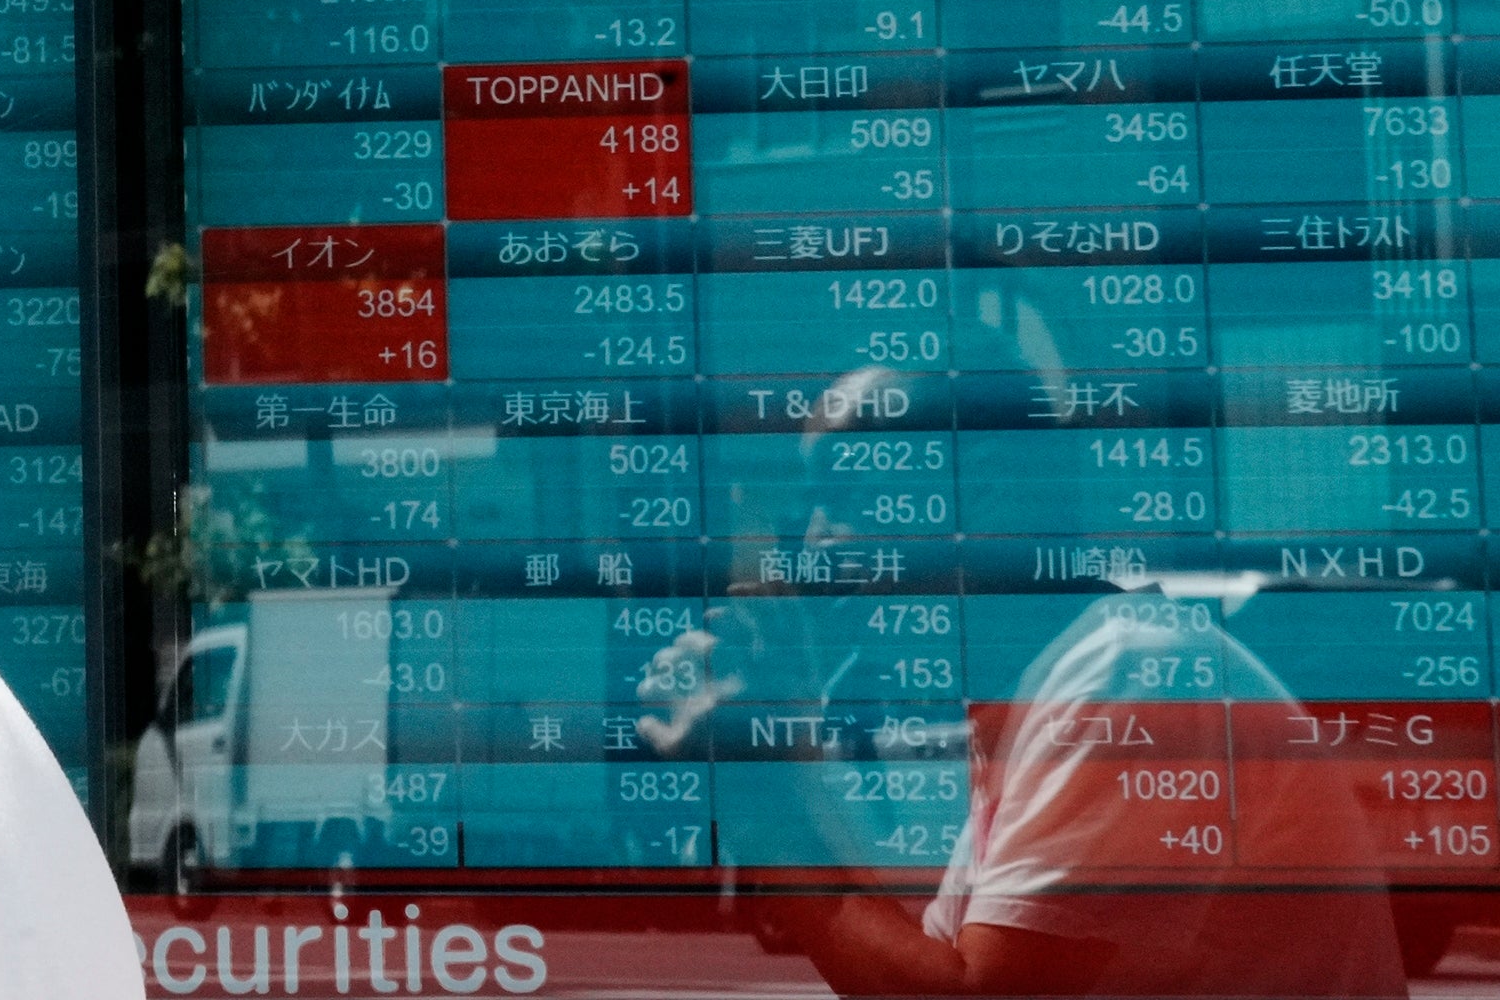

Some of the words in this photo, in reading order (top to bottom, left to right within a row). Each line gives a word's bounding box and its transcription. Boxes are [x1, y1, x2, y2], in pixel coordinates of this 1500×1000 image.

[760, 64, 868, 100] 大日印
[1013, 60, 1125, 94] ヤマハ
[1270, 52, 1382, 87] 任天堂
[467, 73, 664, 106] TOPPANHD
[600, 125, 679, 153] 4188
[850, 119, 931, 147] 5069
[1105, 113, 1187, 142] 3456
[354, 132, 431, 159] 3229
[623, 178, 680, 203] +14
[500, 229, 639, 263] あおぞら
[753, 225, 889, 262] 三菱UFJ
[997, 220, 1159, 254] りそなHD
[273, 236, 374, 269] イオン
[357, 289, 434, 317] 3854
[574, 285, 684, 313] 2483.5
[827, 279, 937, 308] 1422.0
[1082, 275, 1194, 304] 1028.0
[378, 342, 437, 369] +16
[584, 337, 685, 365] -124.5
[255, 393, 397, 429] 第一生命
[503, 391, 646, 425] 東京海上
[1029, 383, 1139, 417] 三井不
[1287, 378, 1400, 414] 菱地所
[609, 446, 688, 474] 5024
[1090, 438, 1202, 468] 1414.5
[252, 557, 410, 587] ヤマトHD
[759, 549, 904, 584] 商船三井
[1034, 547, 1147, 581] 川崎船
[868, 605, 950, 633] 4736
[1392, 603, 1474, 631] 7024
[281, 718, 384, 750] 大ガス
[1046, 714, 1153, 746] セコム
[1288, 714, 1433, 746] コナミG
[619, 772, 700, 801] 5832
[1117, 771, 1219, 799] 10820
[1381, 771, 1487, 799] 13230
[1159, 826, 1222, 854] +40
[1404, 826, 1489, 855] +105
[134, 903, 547, 996] curities
